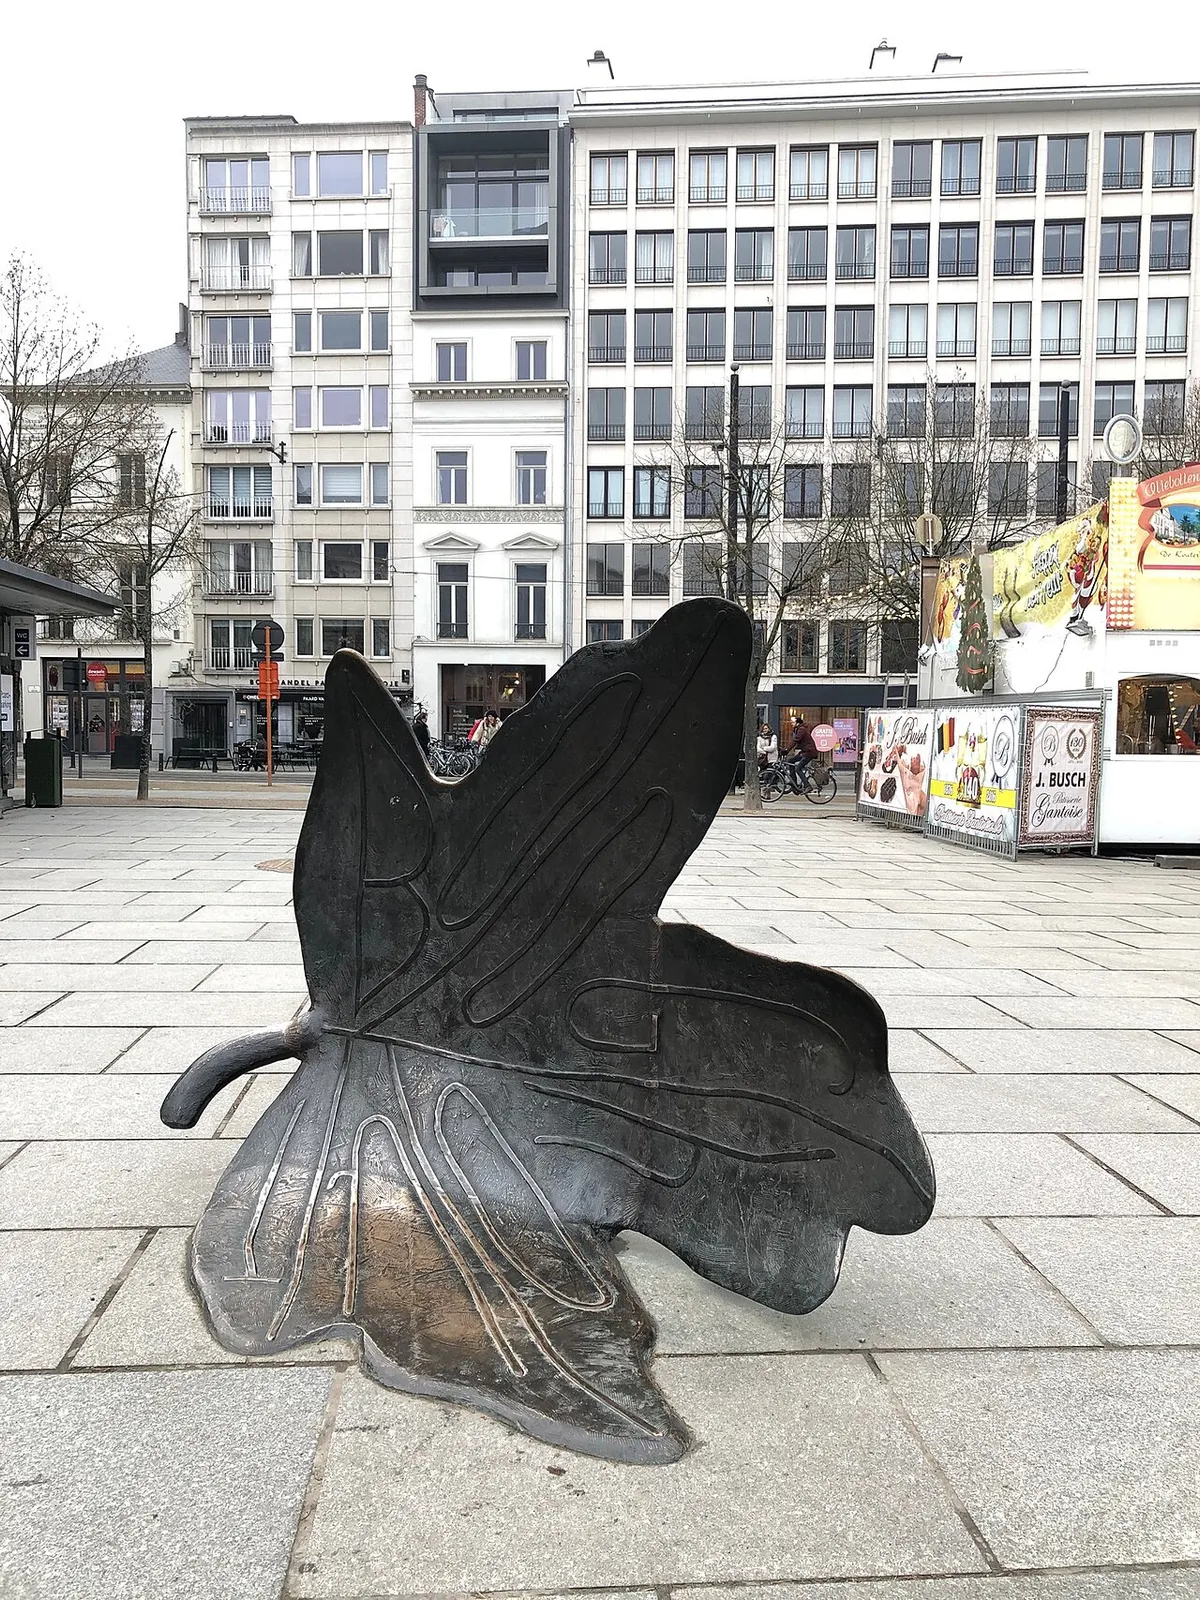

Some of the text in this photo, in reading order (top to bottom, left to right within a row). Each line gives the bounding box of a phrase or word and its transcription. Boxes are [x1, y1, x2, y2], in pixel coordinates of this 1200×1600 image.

[964, 776, 979, 800] 140
[1036, 772, 1086, 787] J. BUSCH
[1032, 793, 1083, 827] Gantoise
